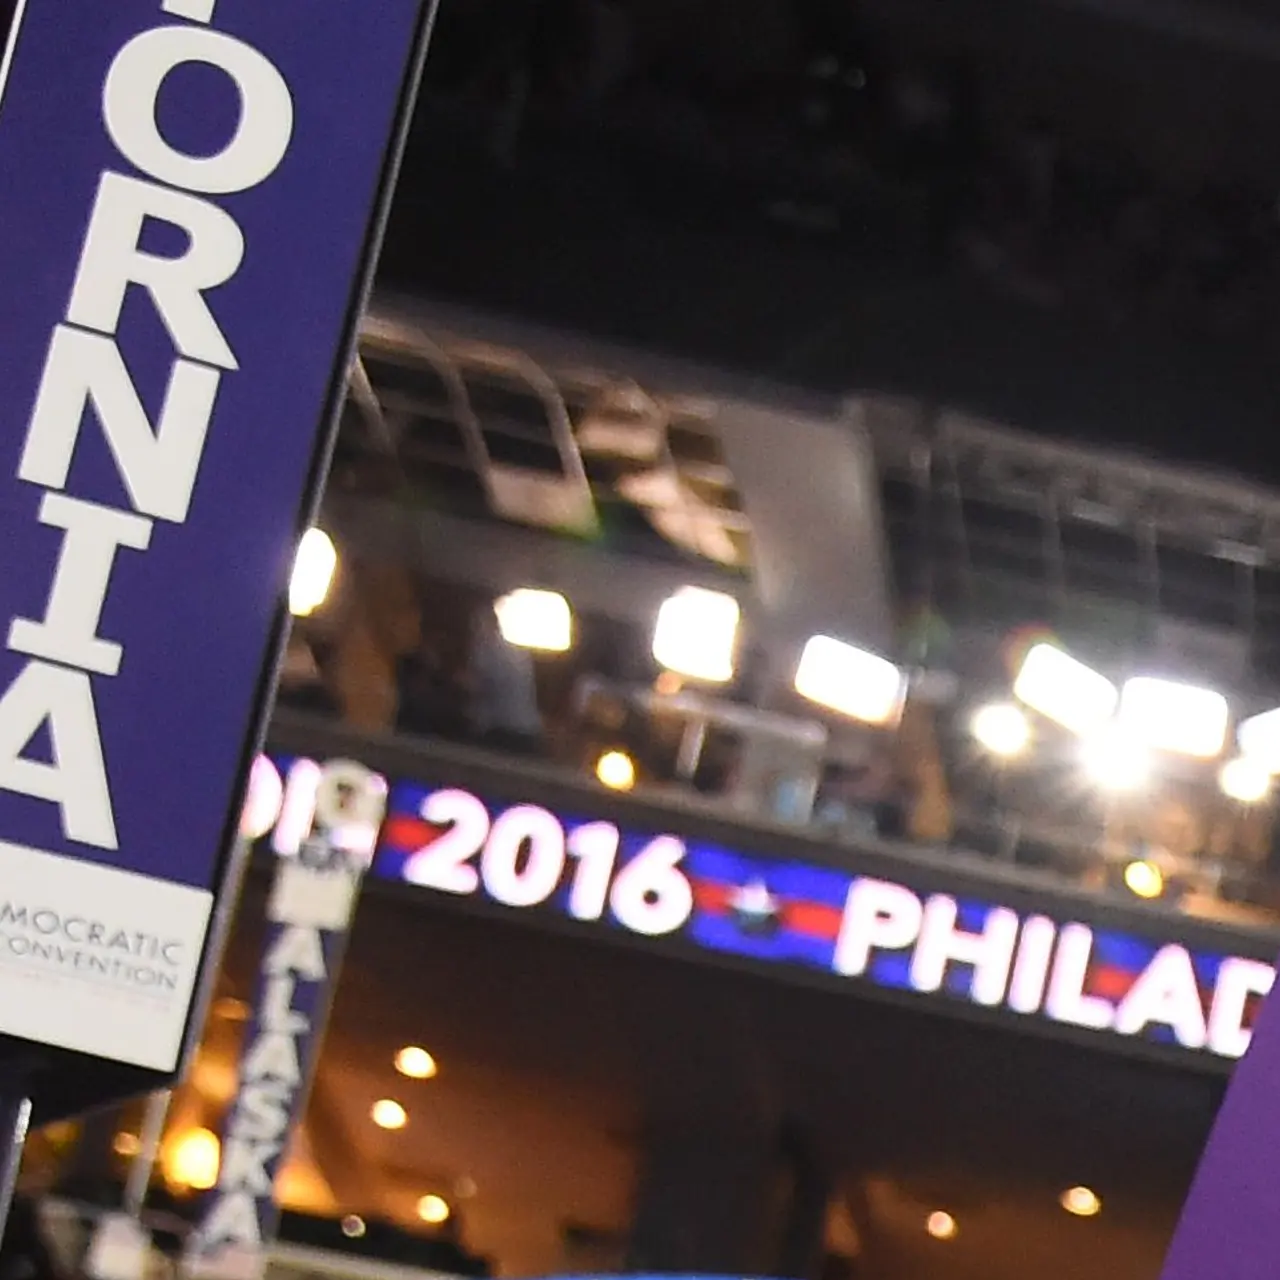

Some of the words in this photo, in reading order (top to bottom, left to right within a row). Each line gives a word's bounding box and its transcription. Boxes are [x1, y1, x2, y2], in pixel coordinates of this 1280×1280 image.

[0, 0, 293, 851] ORNIA
[0, 930, 179, 991] ONVENTION
[403, 787, 693, 935] 2016
[199, 926, 330, 1247] ALASKA
